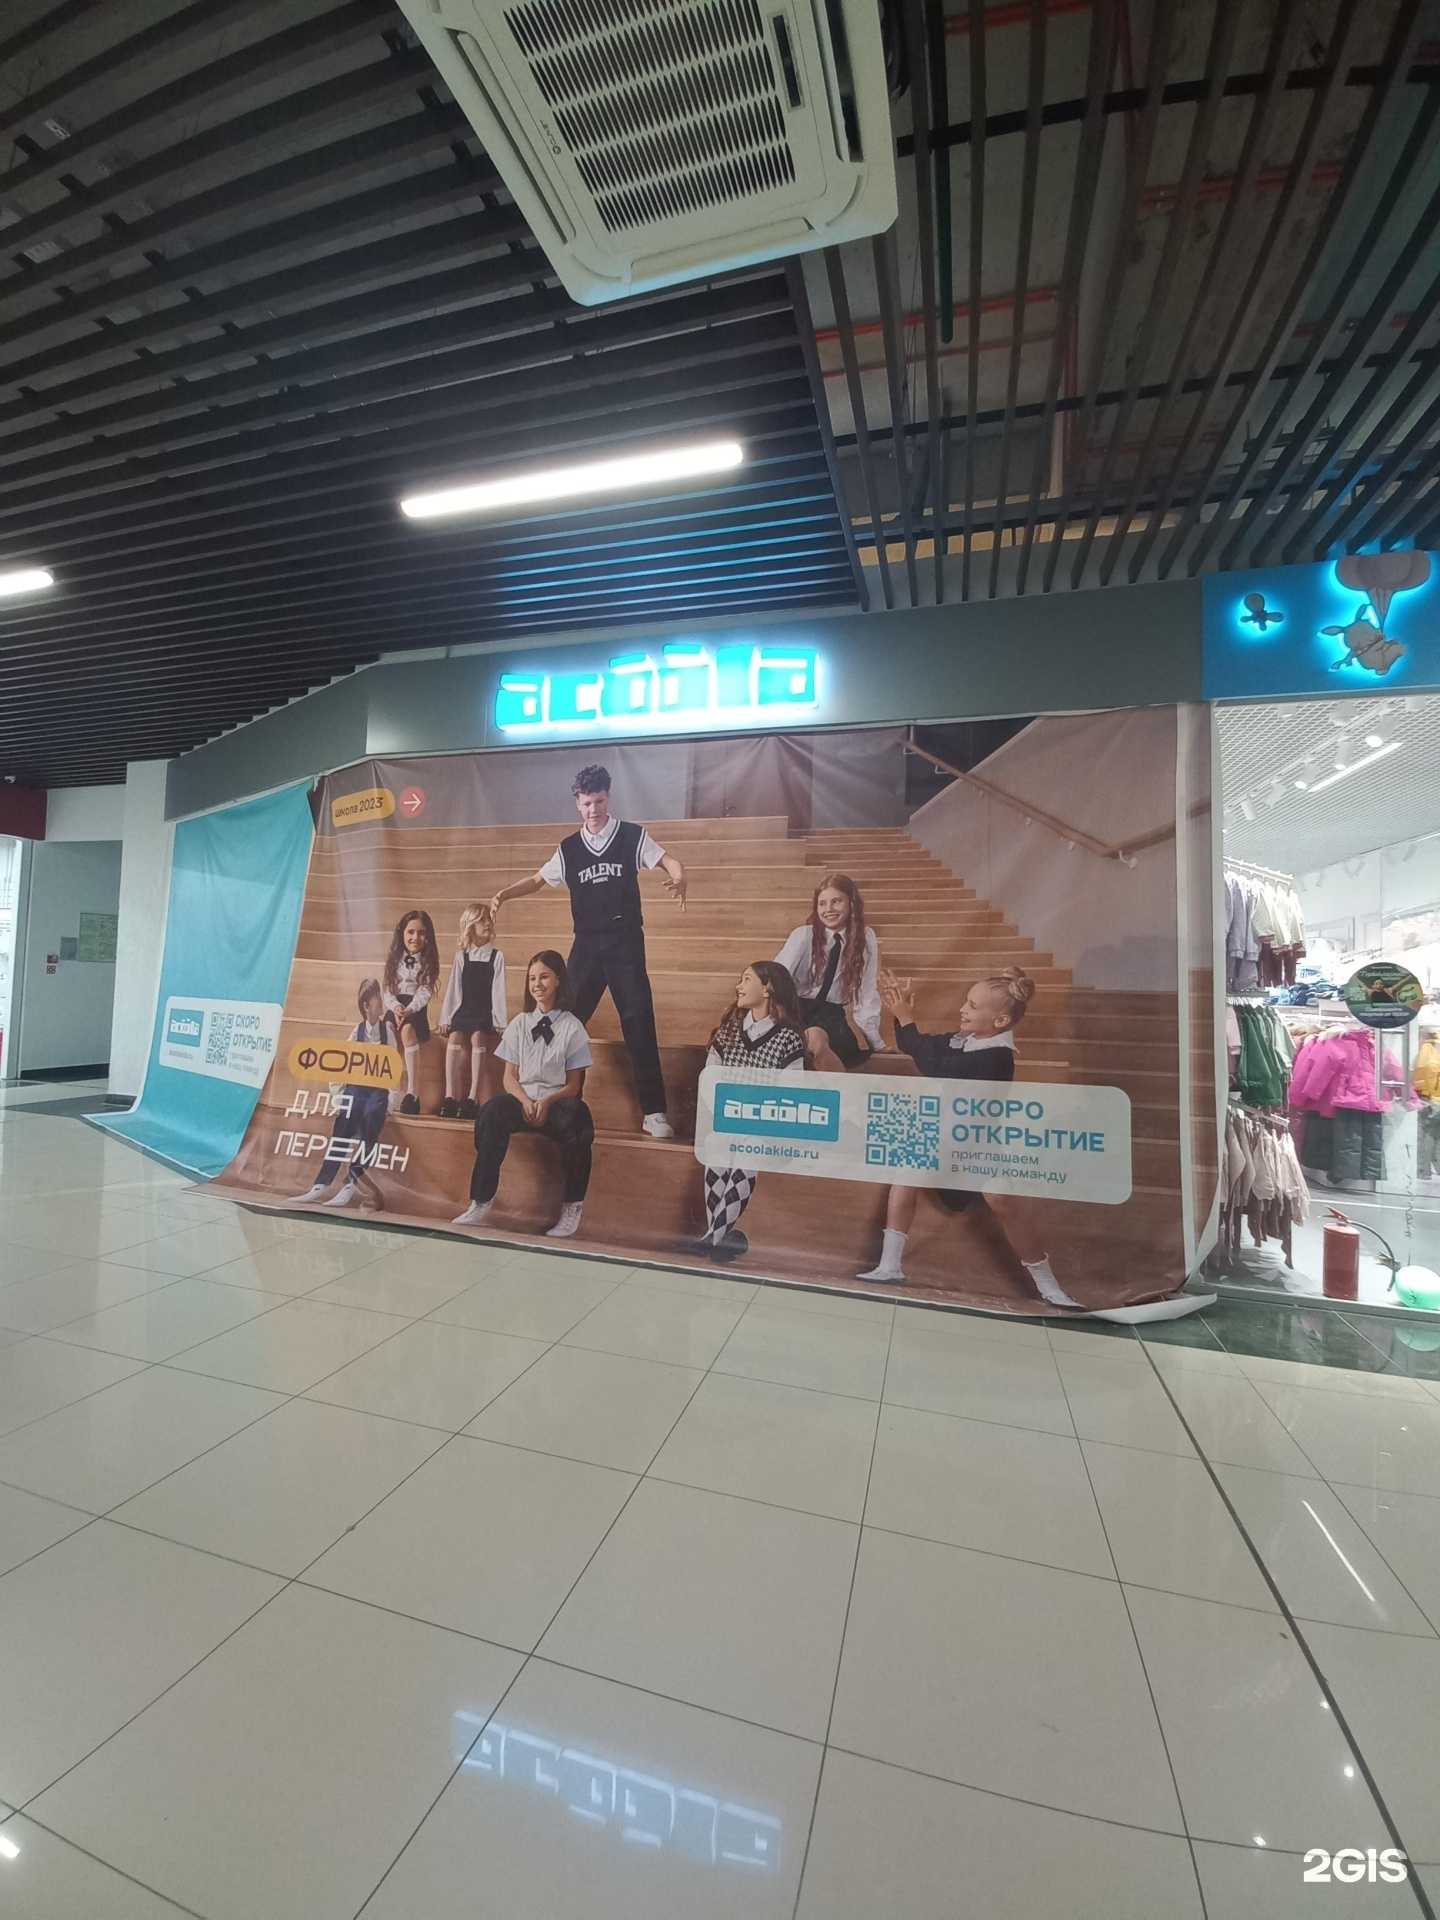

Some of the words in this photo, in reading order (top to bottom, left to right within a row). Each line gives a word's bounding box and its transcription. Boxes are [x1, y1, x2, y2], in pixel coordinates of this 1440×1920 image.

[359, 797, 385, 812] 2023
[578, 863, 623, 884] TALENT
[235, 1014, 261, 1030] СКОРО
[232, 1033, 273, 1053] ОТКРЫТИЕ
[298, 1048, 393, 1080] ФОРМА
[284, 1089, 354, 1120] ДЛЯ
[952, 1096, 1045, 1120] СКОРО
[951, 1124, 1106, 1153] ОТКРЫТИЕ
[274, 1131, 410, 1172] ПЕРЕМЕН
[728, 1142, 820, 1160] acoolakids.ru
[951, 1150, 1040, 1166] приглашаем
[951, 1163, 960, 1172] в
[962, 1164, 999, 1180] нашу
[1001, 1168, 1068, 1184] команду
